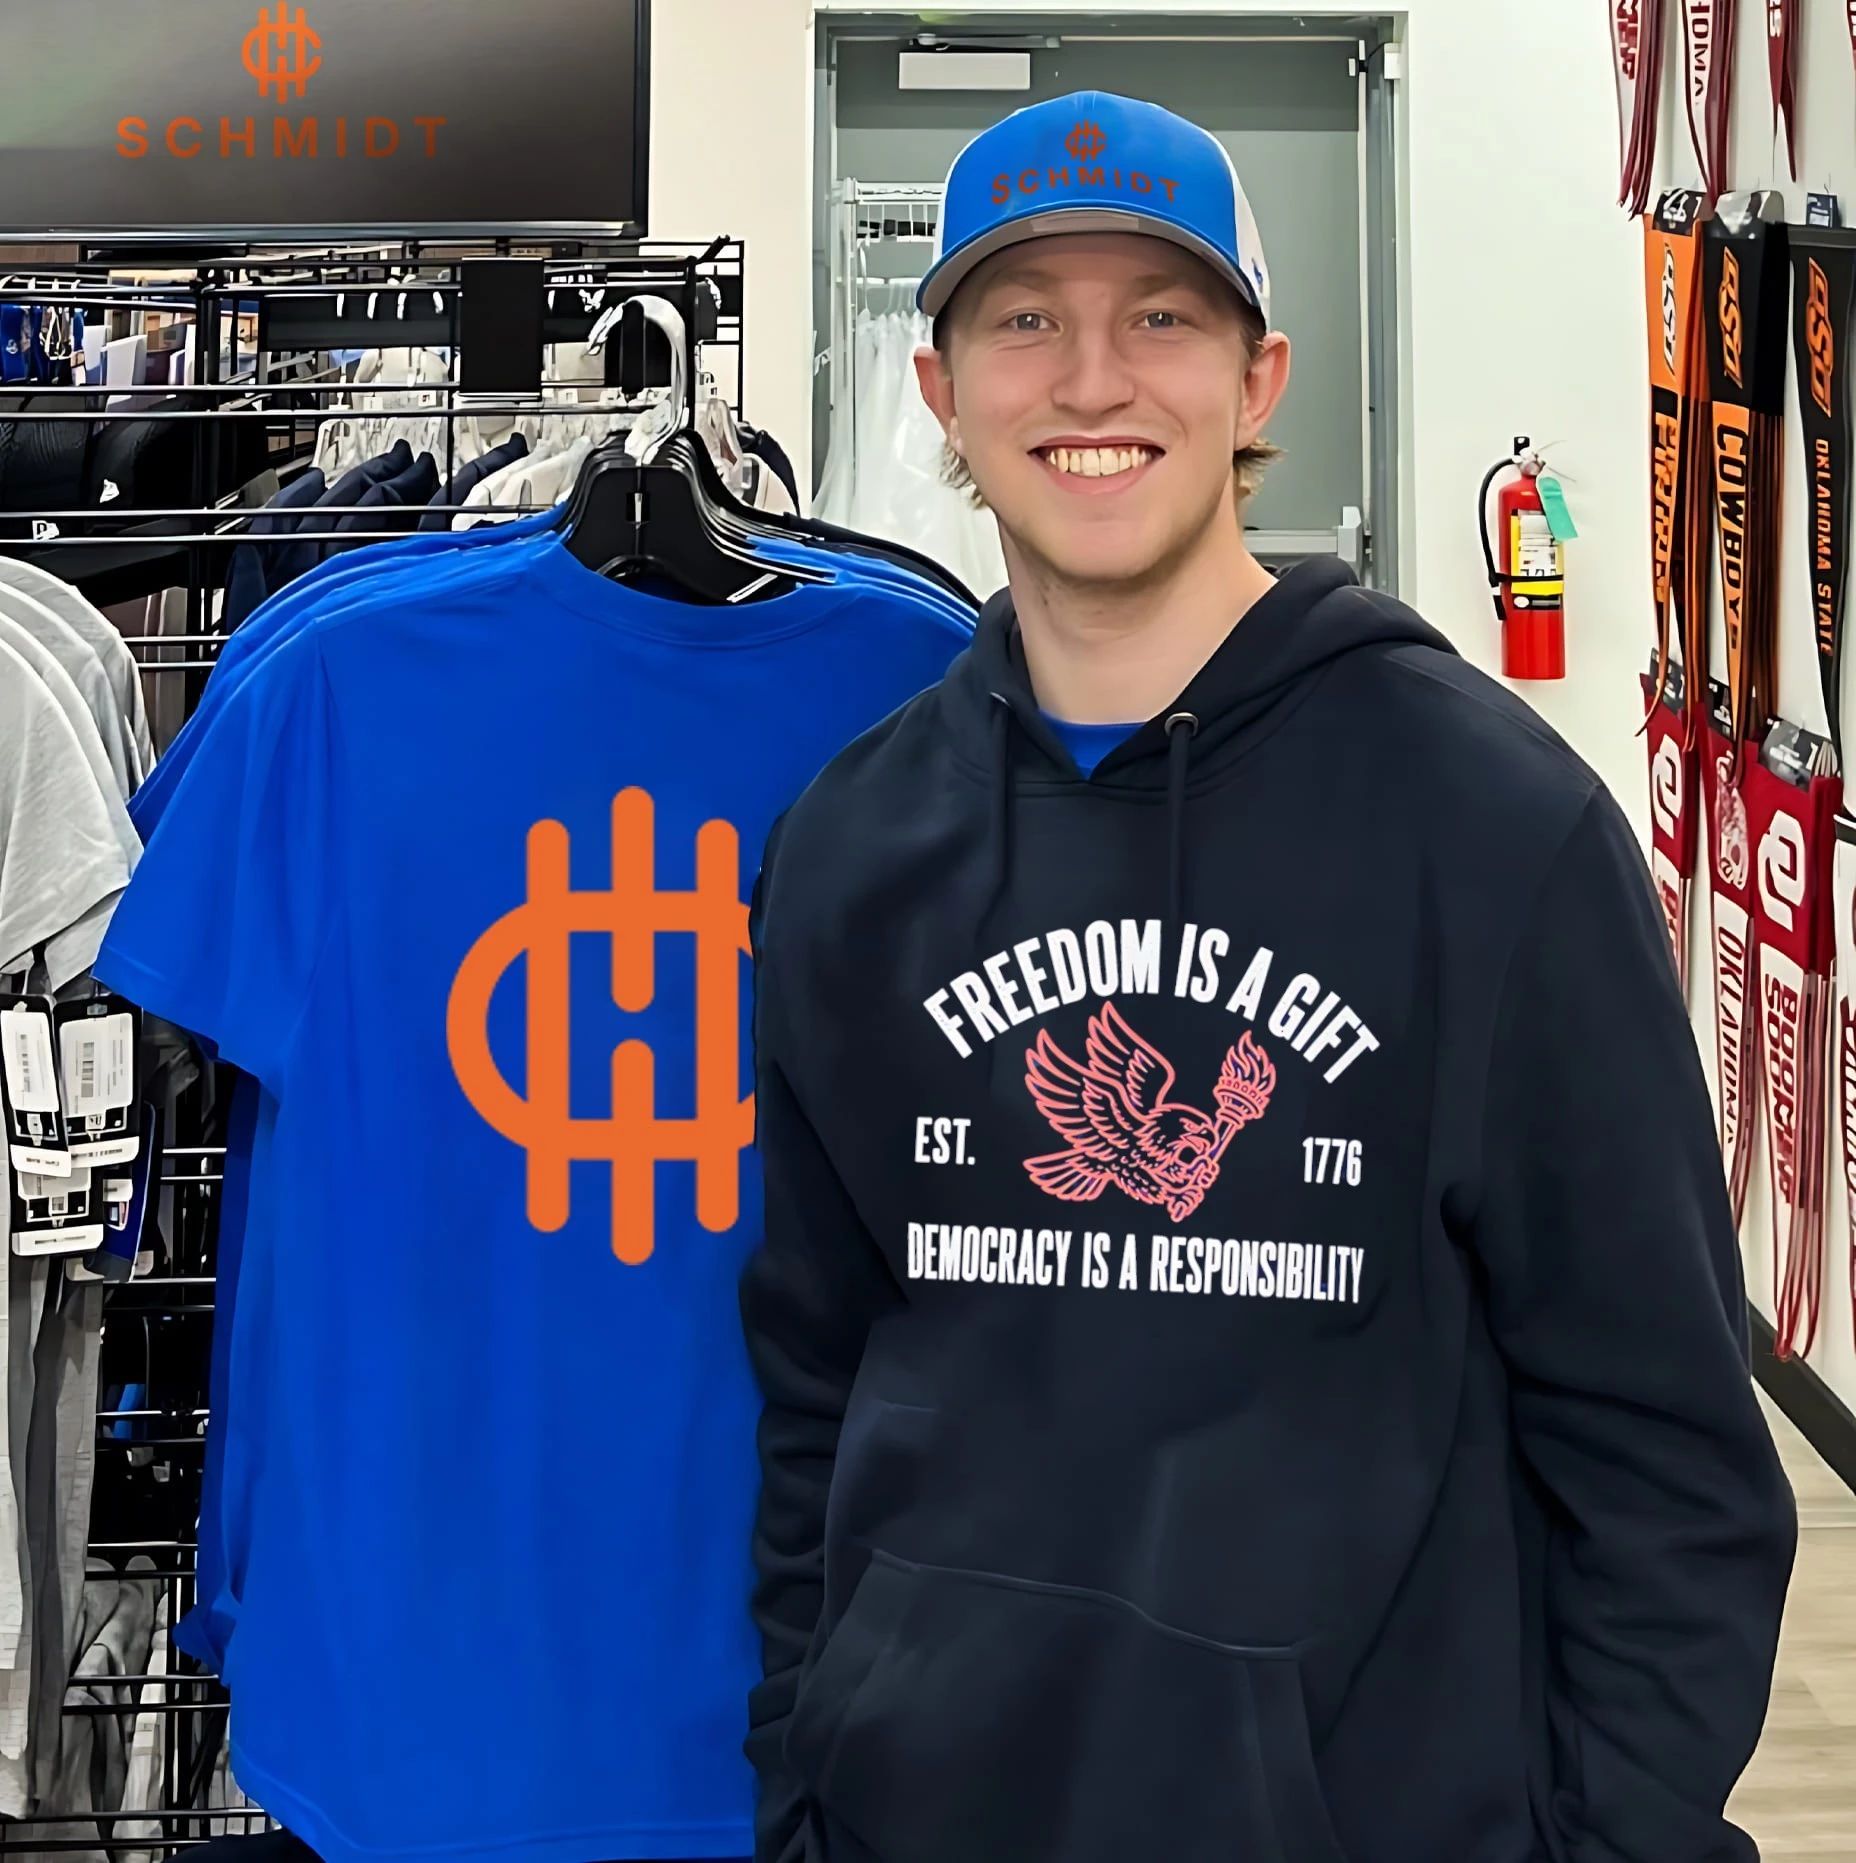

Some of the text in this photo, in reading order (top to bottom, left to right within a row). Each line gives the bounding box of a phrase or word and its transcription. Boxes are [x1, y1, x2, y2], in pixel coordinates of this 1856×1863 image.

[114, 114, 448, 160] SCHMIDT
[991, 166, 1180, 205] SCHMIDT
[1815, 438, 1832, 570] OKLAHOMA
[923, 918, 1380, 1084] FREEDOM IS A GIFT
[914, 1116, 1363, 1187] EST. 1776
[907, 1222, 1365, 1304] DEMOCRACY IS A RESPONSIBILITY
